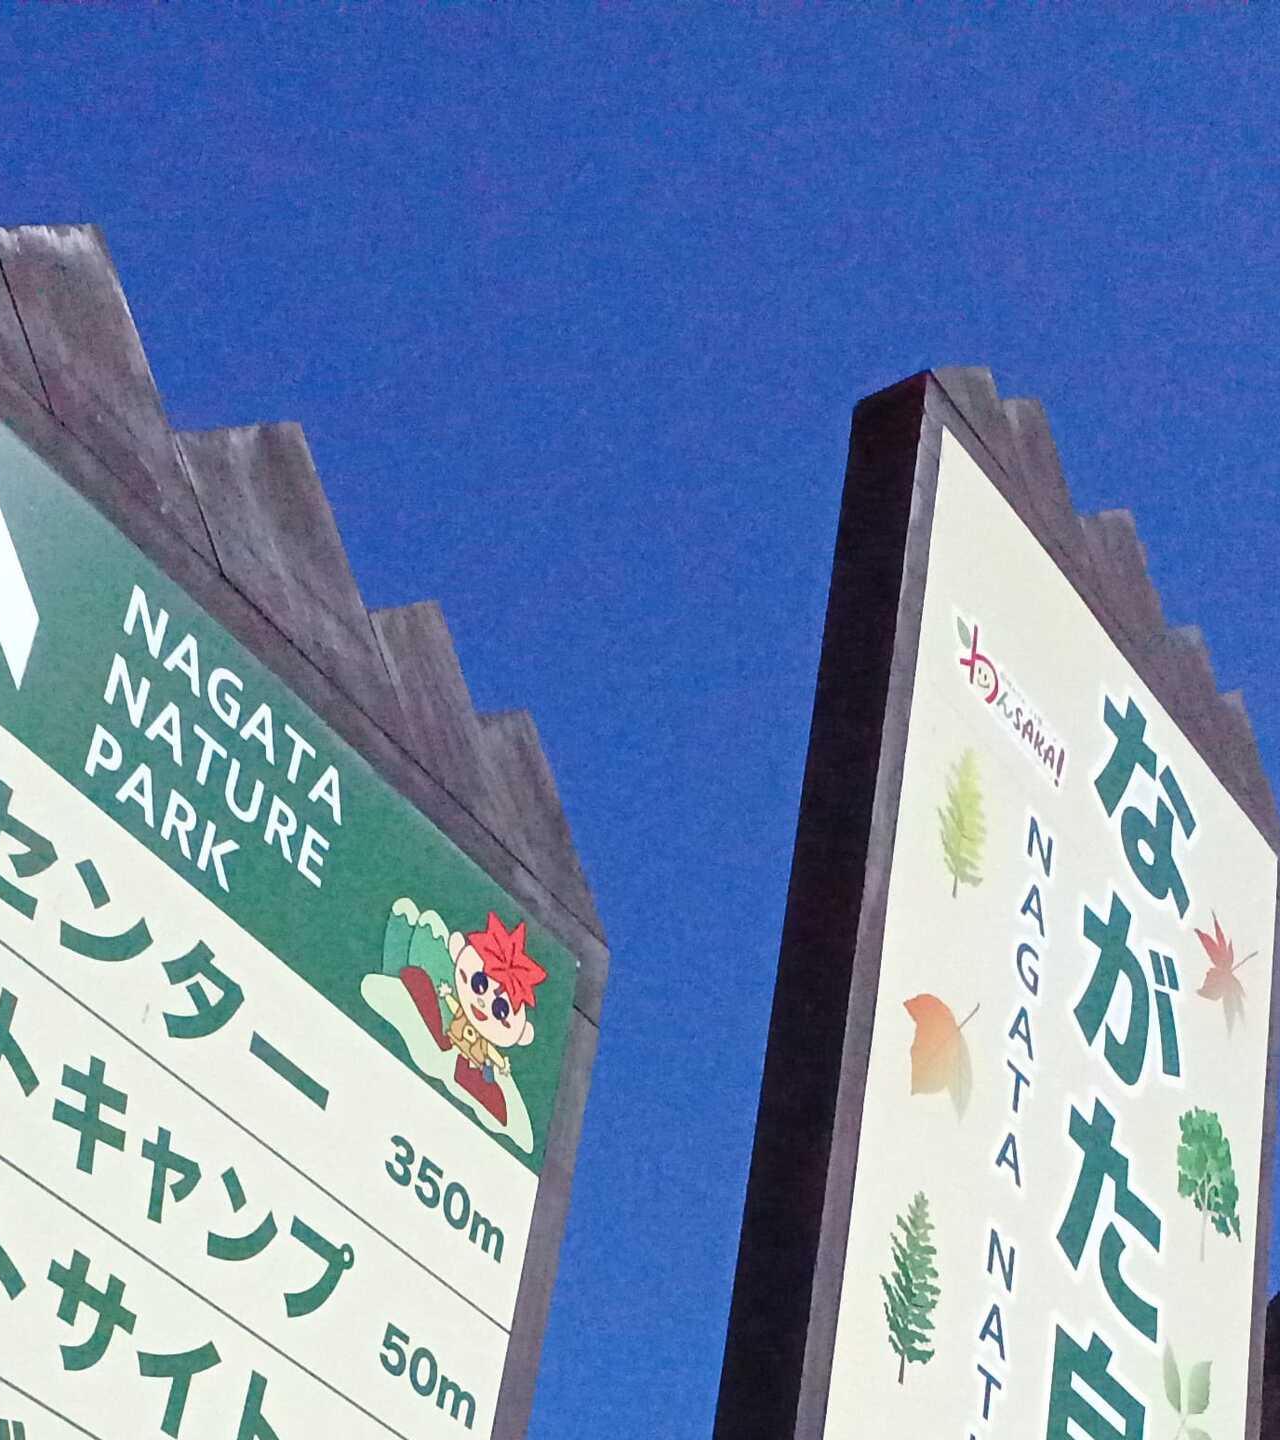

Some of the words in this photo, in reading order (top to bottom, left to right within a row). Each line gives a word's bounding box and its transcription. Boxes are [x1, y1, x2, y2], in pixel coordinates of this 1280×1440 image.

[102, 653, 331, 888] NATURE
[122, 584, 344, 826] NAGATA
[84, 724, 241, 893] PARK
[995, 816, 1054, 1188] NAGATA
[385, 1135, 505, 1264] 350m
[379, 1322, 477, 1430] 50m
